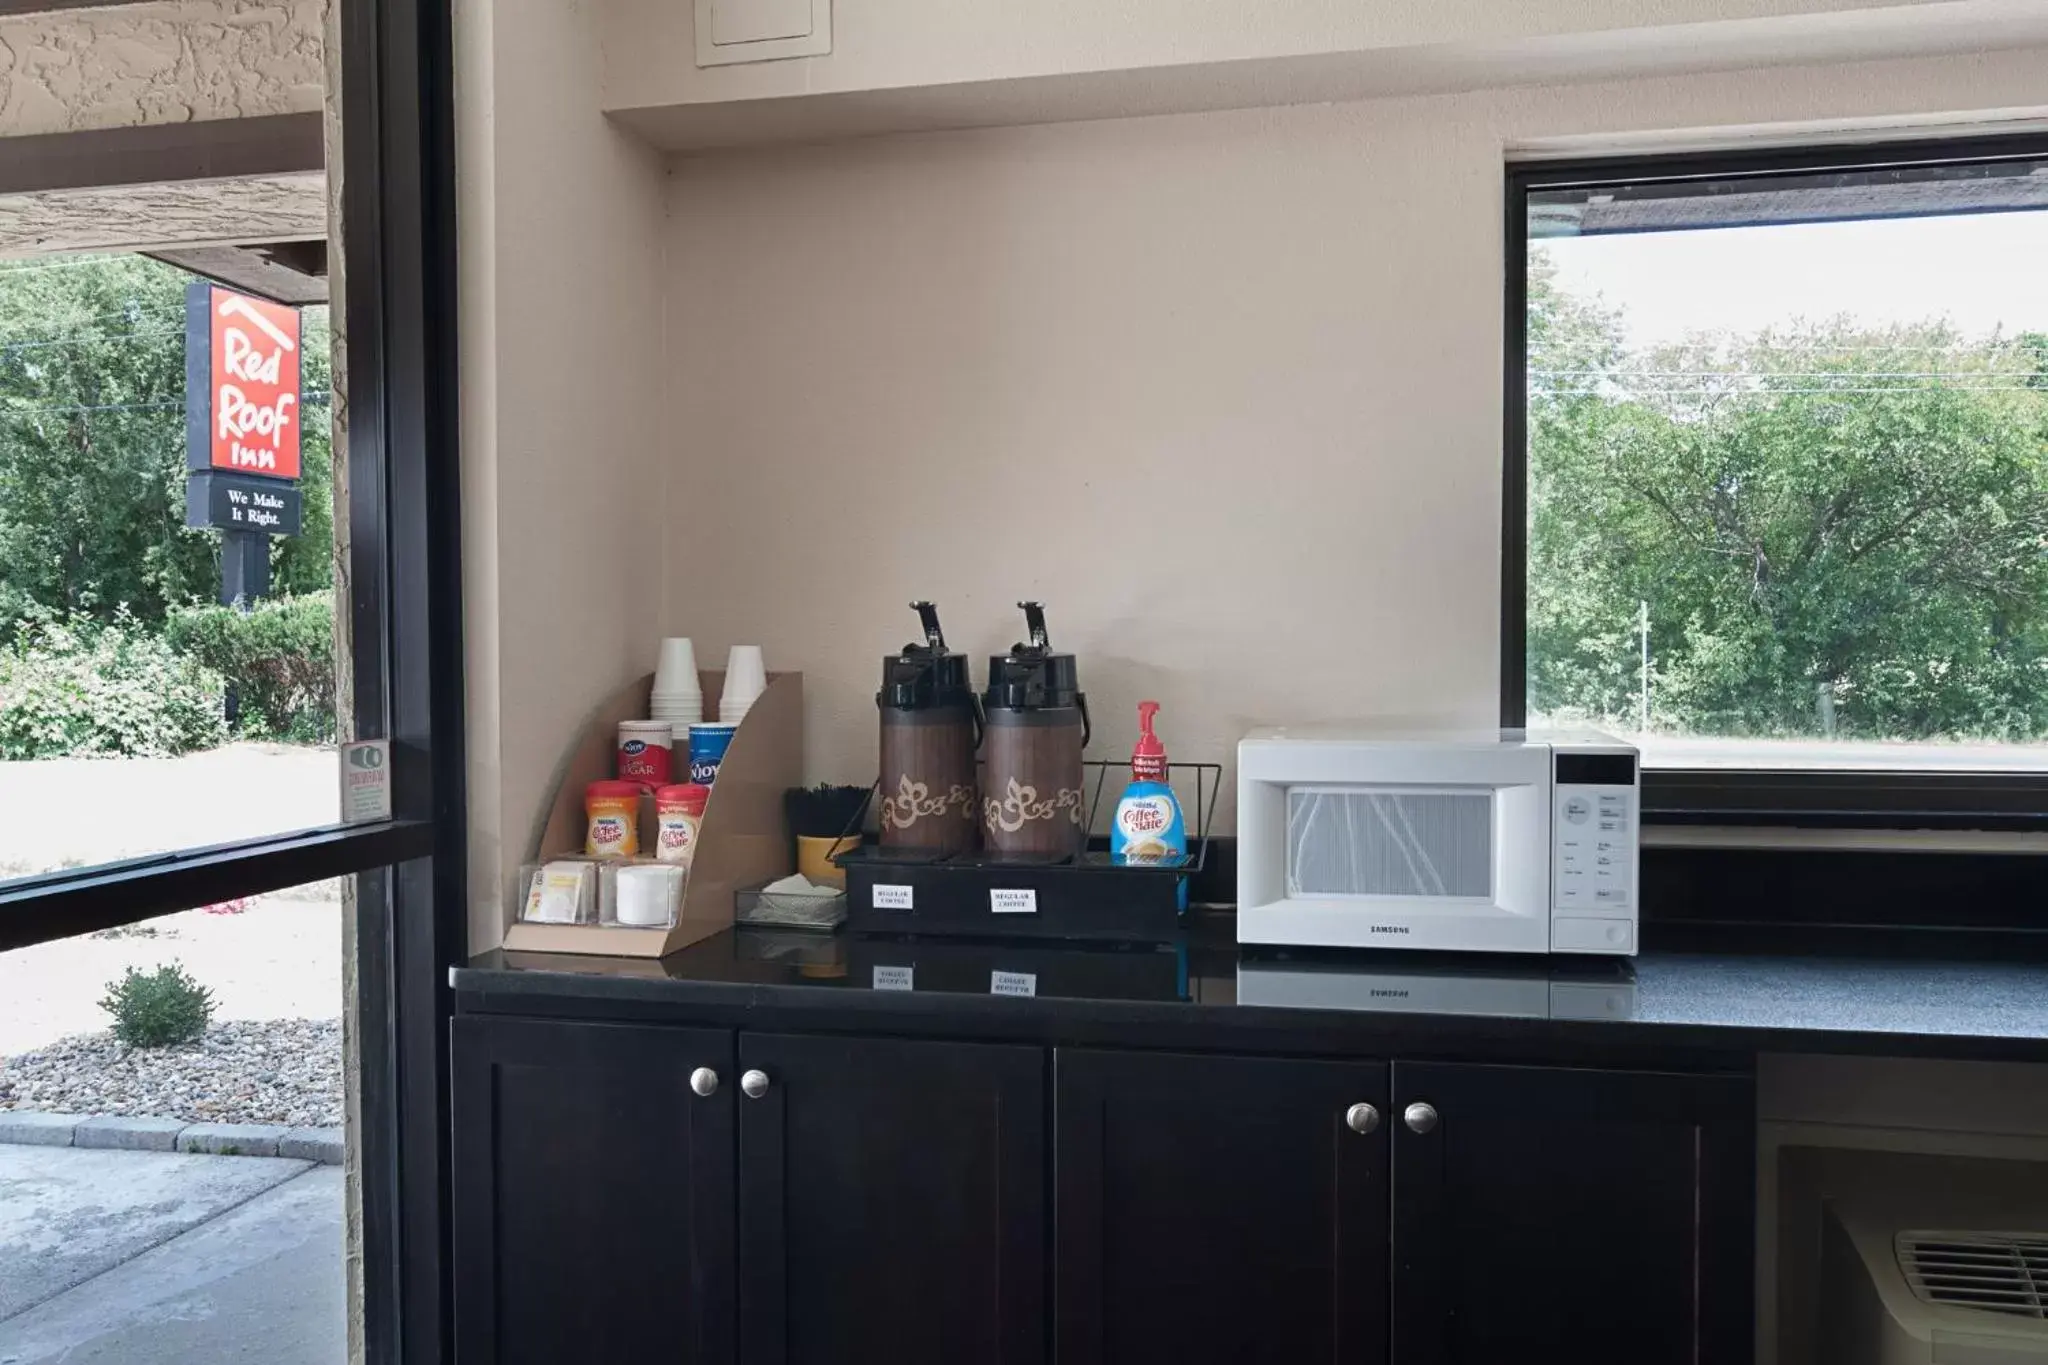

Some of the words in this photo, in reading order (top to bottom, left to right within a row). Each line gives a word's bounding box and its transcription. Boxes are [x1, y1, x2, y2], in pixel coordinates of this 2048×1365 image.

[224, 327, 281, 385] Red
[218, 384, 295, 448] Roof
[231, 441, 276, 469] Inn
[227, 489, 248, 505] We
[253, 492, 285, 509] Make
[231, 507, 243, 521] It
[247, 509, 280, 526] Right.
[1124, 808, 1160, 824] Coffee
[1371, 926, 1410, 934] SAMSUNG
